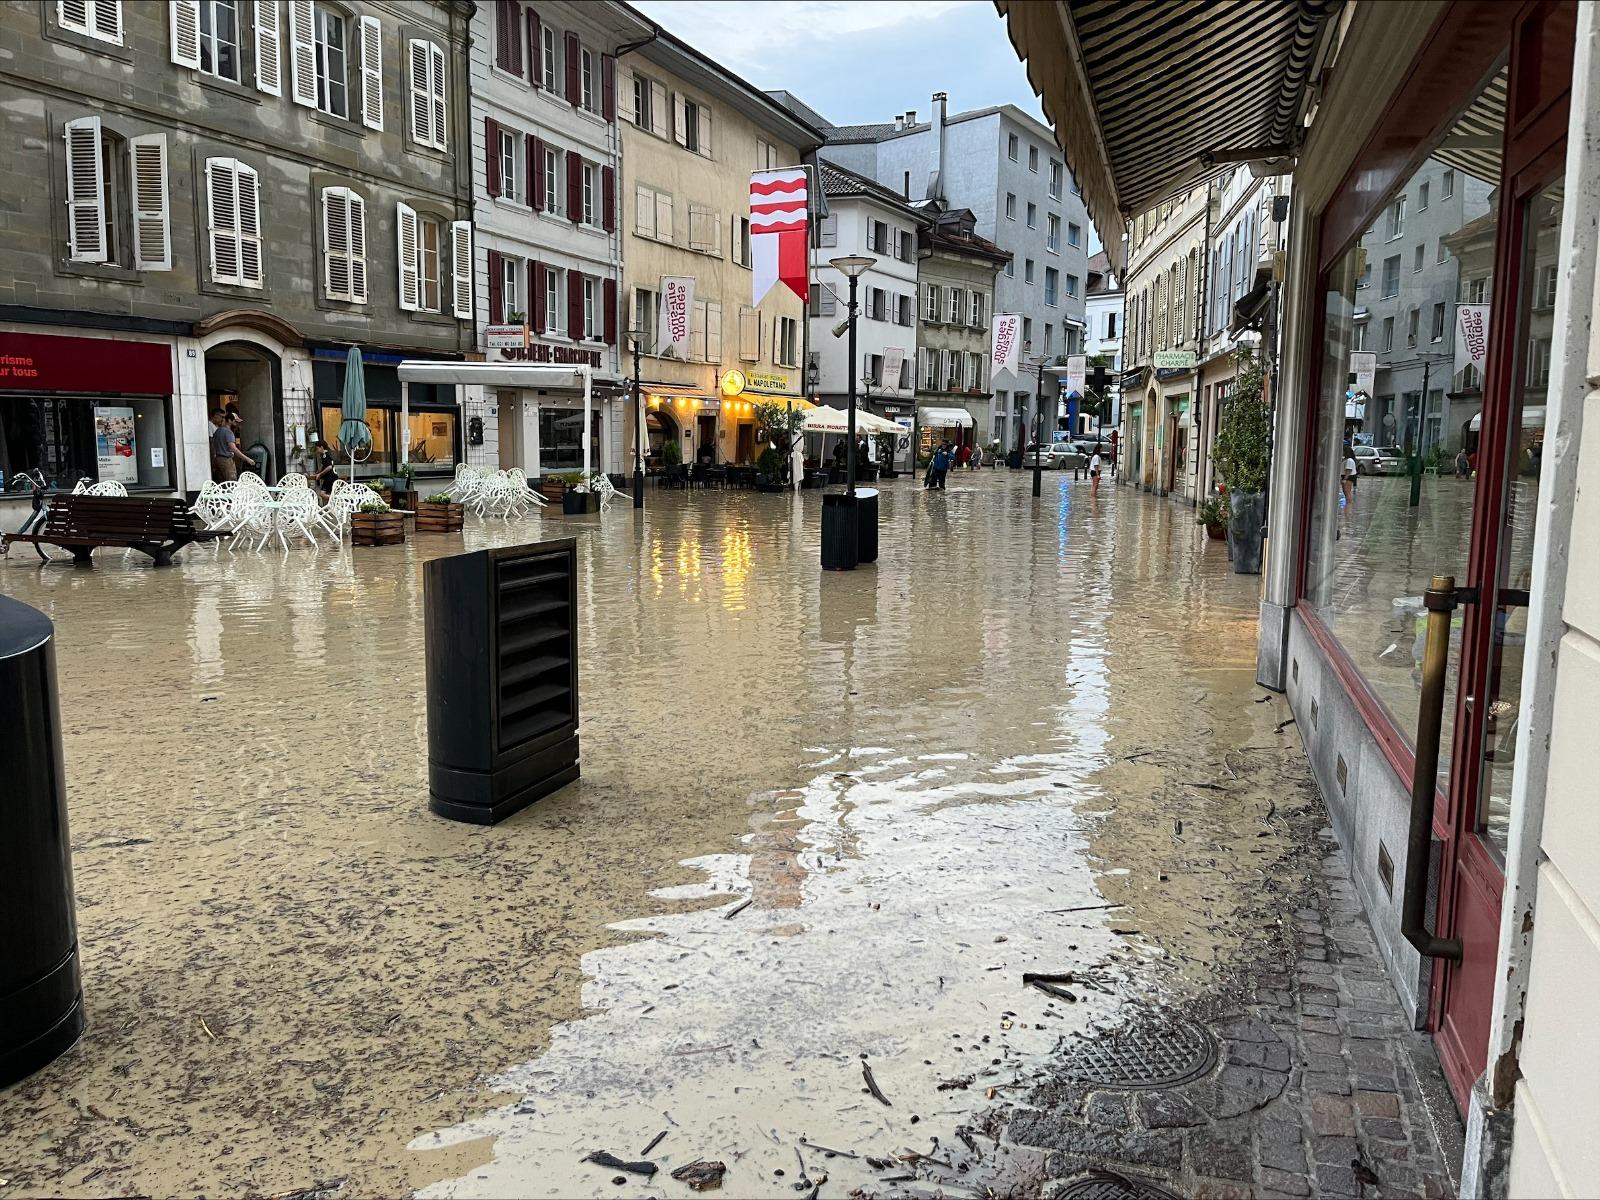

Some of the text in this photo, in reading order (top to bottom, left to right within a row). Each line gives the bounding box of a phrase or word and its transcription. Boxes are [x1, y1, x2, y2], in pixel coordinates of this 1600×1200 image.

[994, 320, 1007, 360] morges
[997, 317, 1016, 365] sous-rire
[1155, 352, 1194, 360] PHARMACIE
[13, 366, 38, 377] tous
[753, 379, 787, 390] NAPOLETANO
